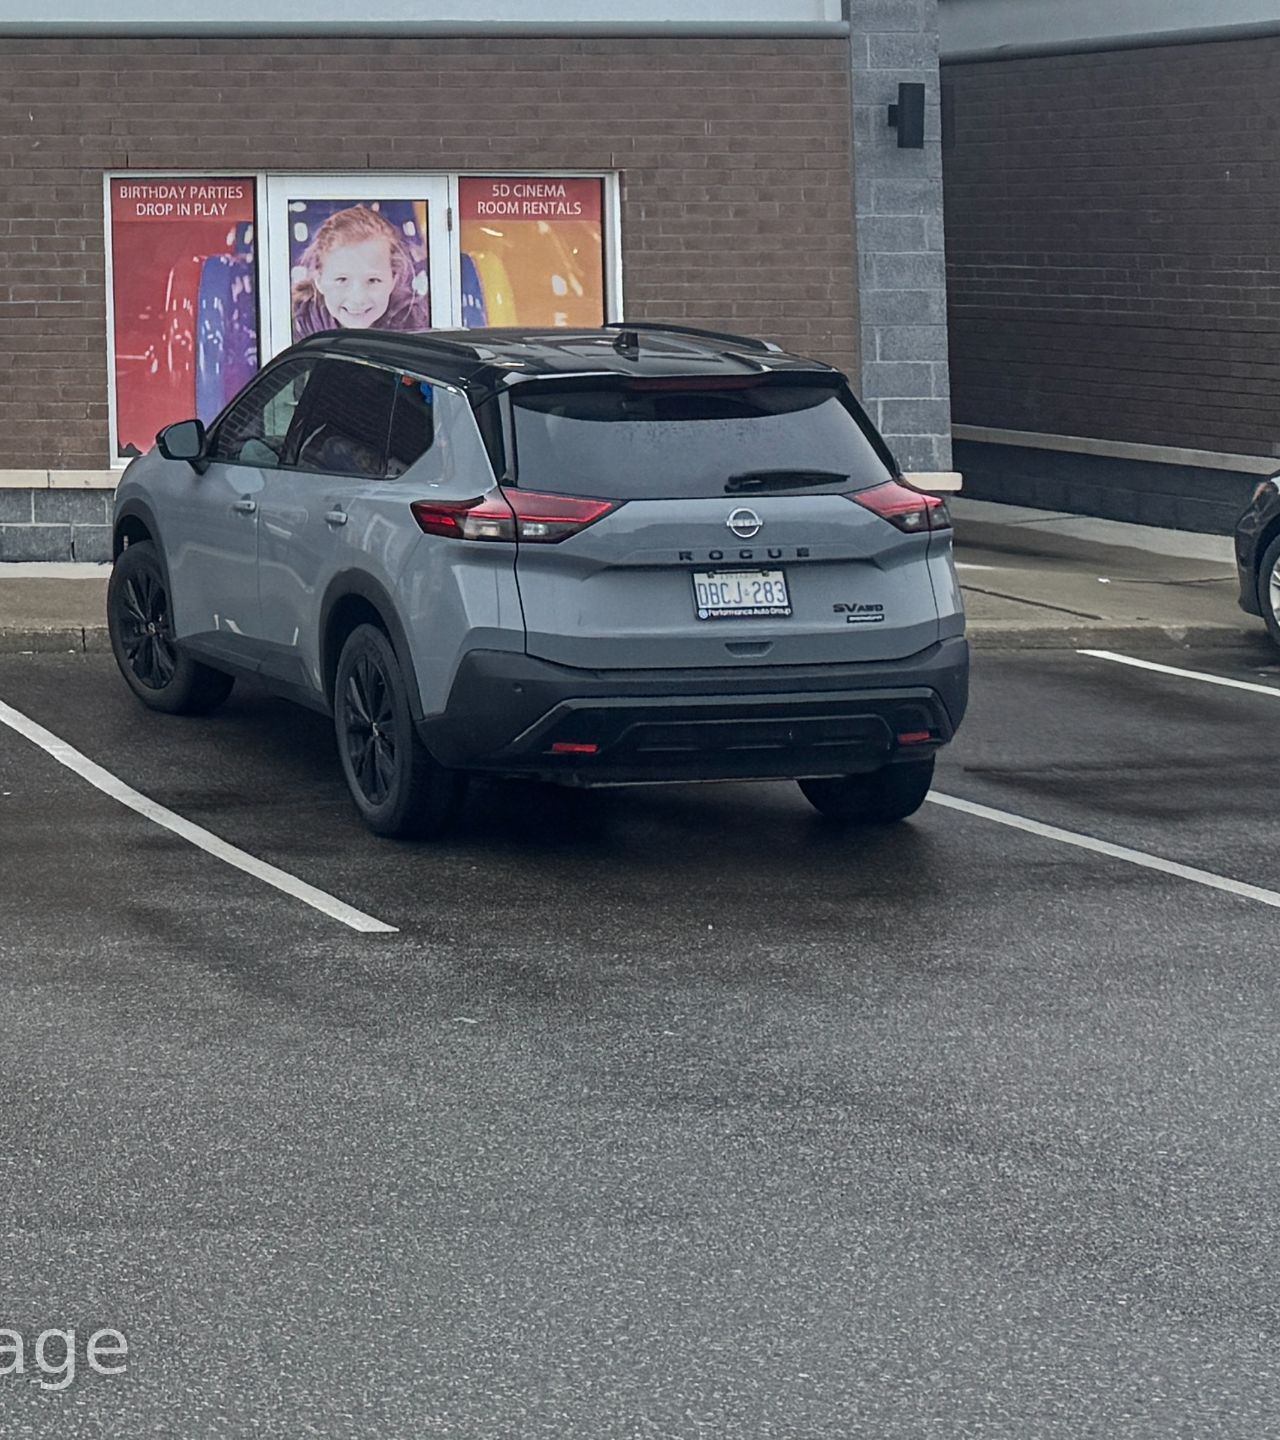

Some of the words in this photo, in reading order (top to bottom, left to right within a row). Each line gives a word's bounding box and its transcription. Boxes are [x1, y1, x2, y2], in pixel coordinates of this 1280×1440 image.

[120, 186, 187, 199] BIRTHDAY
[190, 186, 243, 199] PARTIES
[492, 184, 510, 197] 5D
[513, 184, 566, 197] CINEMA
[136, 203, 173, 216] DROP
[177, 203, 191, 216] IN
[194, 203, 228, 216] PLAY
[477, 201, 519, 215] ROOM
[523, 201, 582, 215] RENTALS
[678, 547, 810, 561] ROGUE
[698, 581, 743, 606] DBCJ
[752, 580, 786, 604] 283
